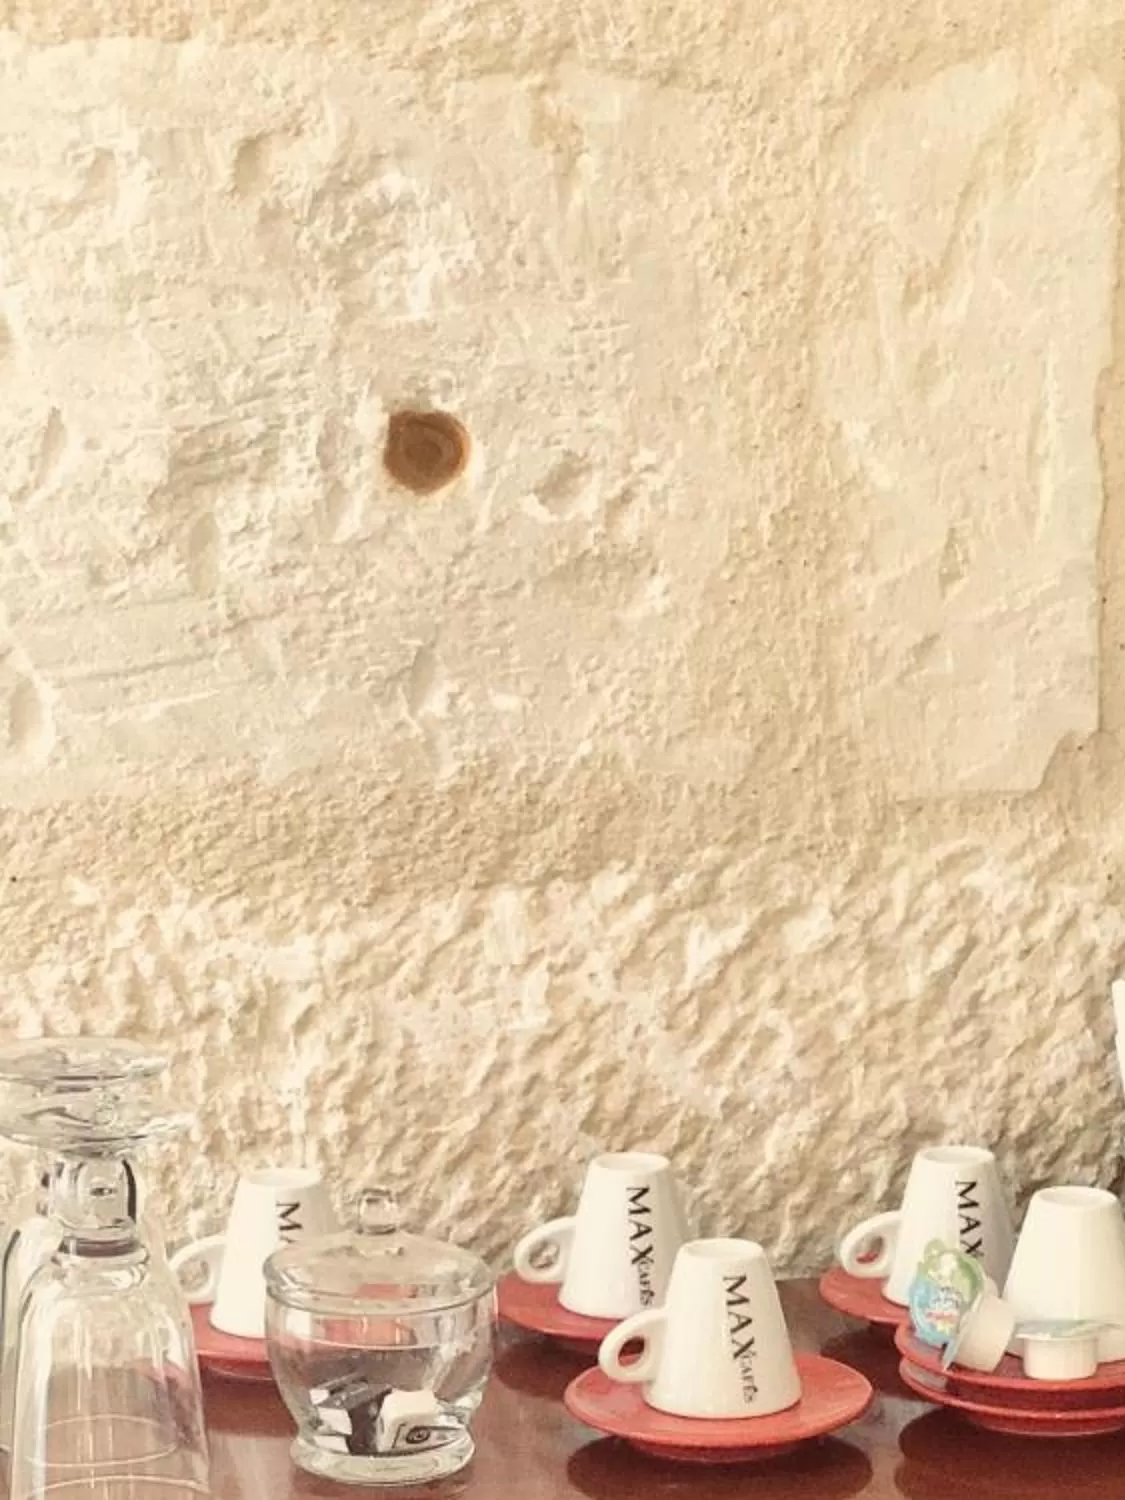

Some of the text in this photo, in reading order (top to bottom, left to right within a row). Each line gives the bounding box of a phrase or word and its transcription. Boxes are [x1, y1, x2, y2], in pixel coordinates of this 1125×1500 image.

[625, 1184, 656, 1265] MAX
[955, 1179, 985, 1257] MAX
[722, 1272, 757, 1360] MAX
